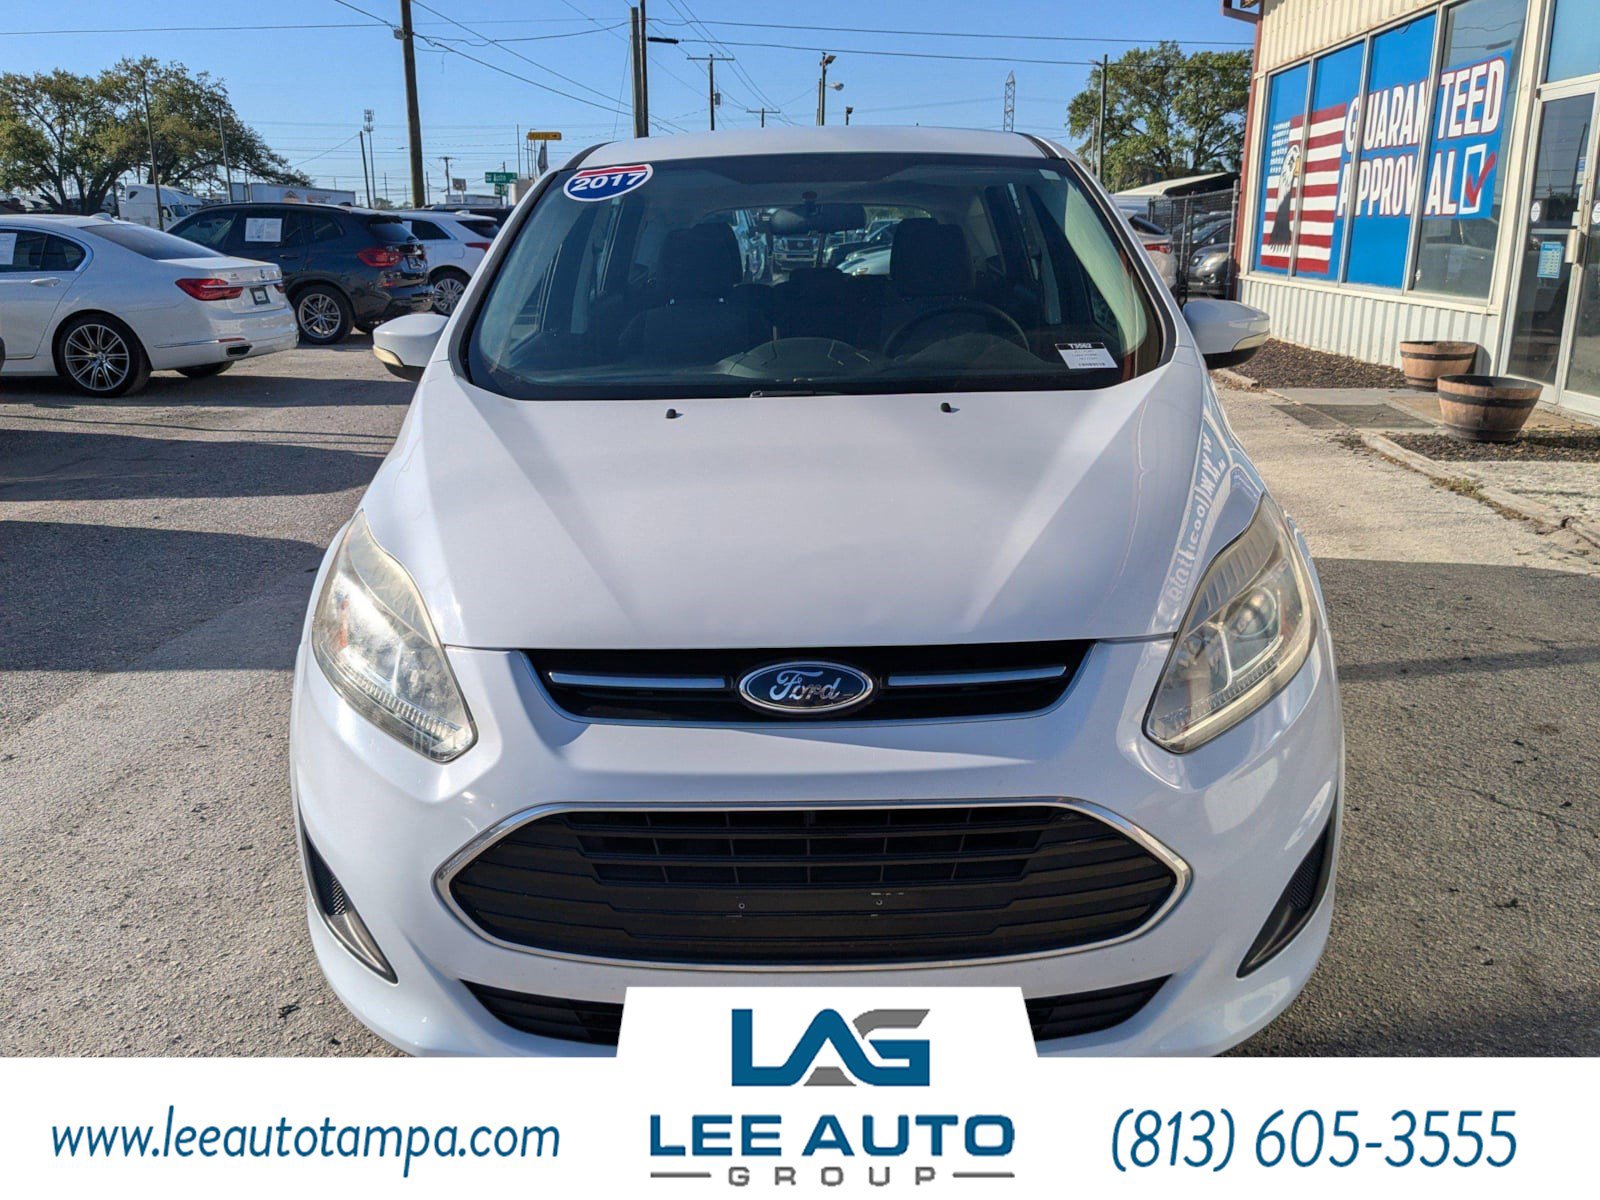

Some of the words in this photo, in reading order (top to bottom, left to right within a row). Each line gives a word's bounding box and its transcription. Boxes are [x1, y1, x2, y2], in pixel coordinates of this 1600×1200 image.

[1345, 57, 1505, 152] GUARANTEED
[570, 172, 647, 192] 2017
[1336, 150, 1457, 216] APPROVAL
[769, 669, 841, 700] Ford
